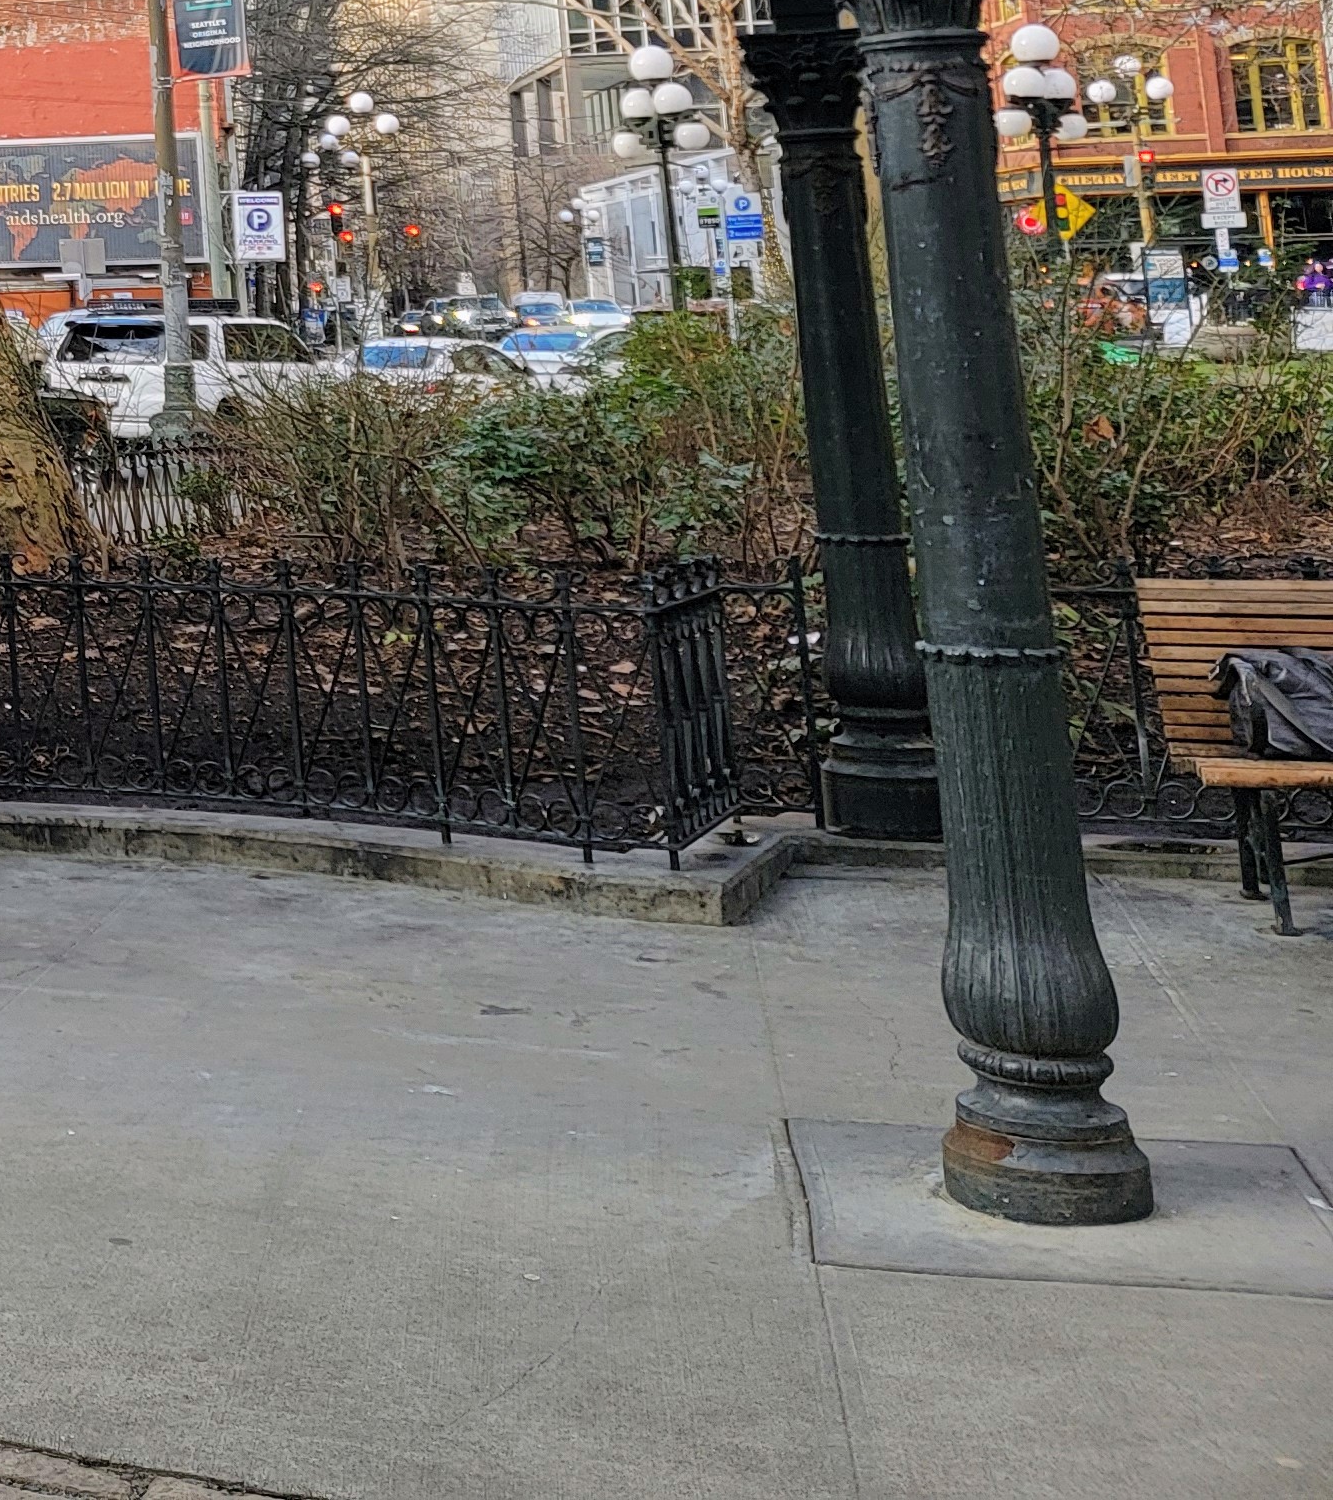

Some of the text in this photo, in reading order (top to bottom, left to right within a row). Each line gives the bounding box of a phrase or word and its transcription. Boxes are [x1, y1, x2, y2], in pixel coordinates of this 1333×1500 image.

[192, 29, 227, 38] ORIGINAL
[183, 37, 241, 49] NEIGHBORHOOD
[1055, 173, 1125, 186] CHERRY
[52, 182, 72, 201] 2.7
[73, 180, 129, 199] MILLION
[134, 179, 150, 198] IN
[6, 207, 126, 228] aidshealth.org
